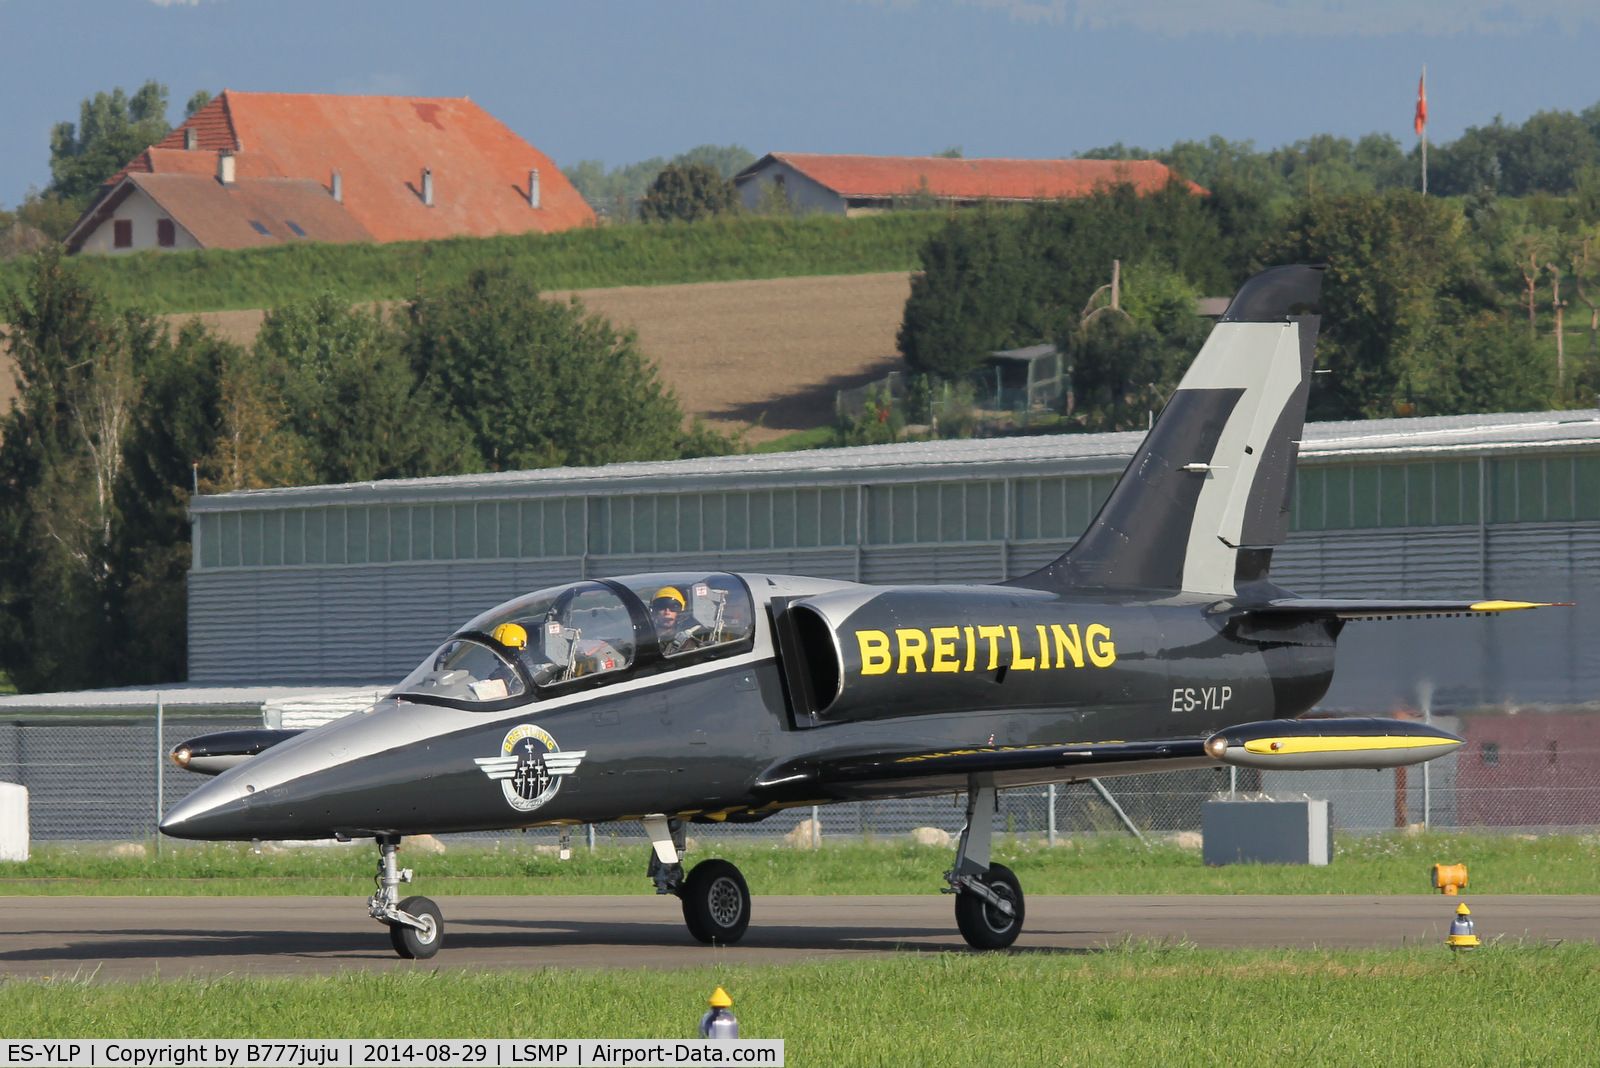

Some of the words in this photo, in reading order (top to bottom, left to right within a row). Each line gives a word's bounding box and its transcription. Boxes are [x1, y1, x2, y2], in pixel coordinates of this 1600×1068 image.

[855, 623, 1117, 675] BREITLING
[1171, 686, 1233, 713] ES-YLP
[504, 726, 555, 753] BREITLING
